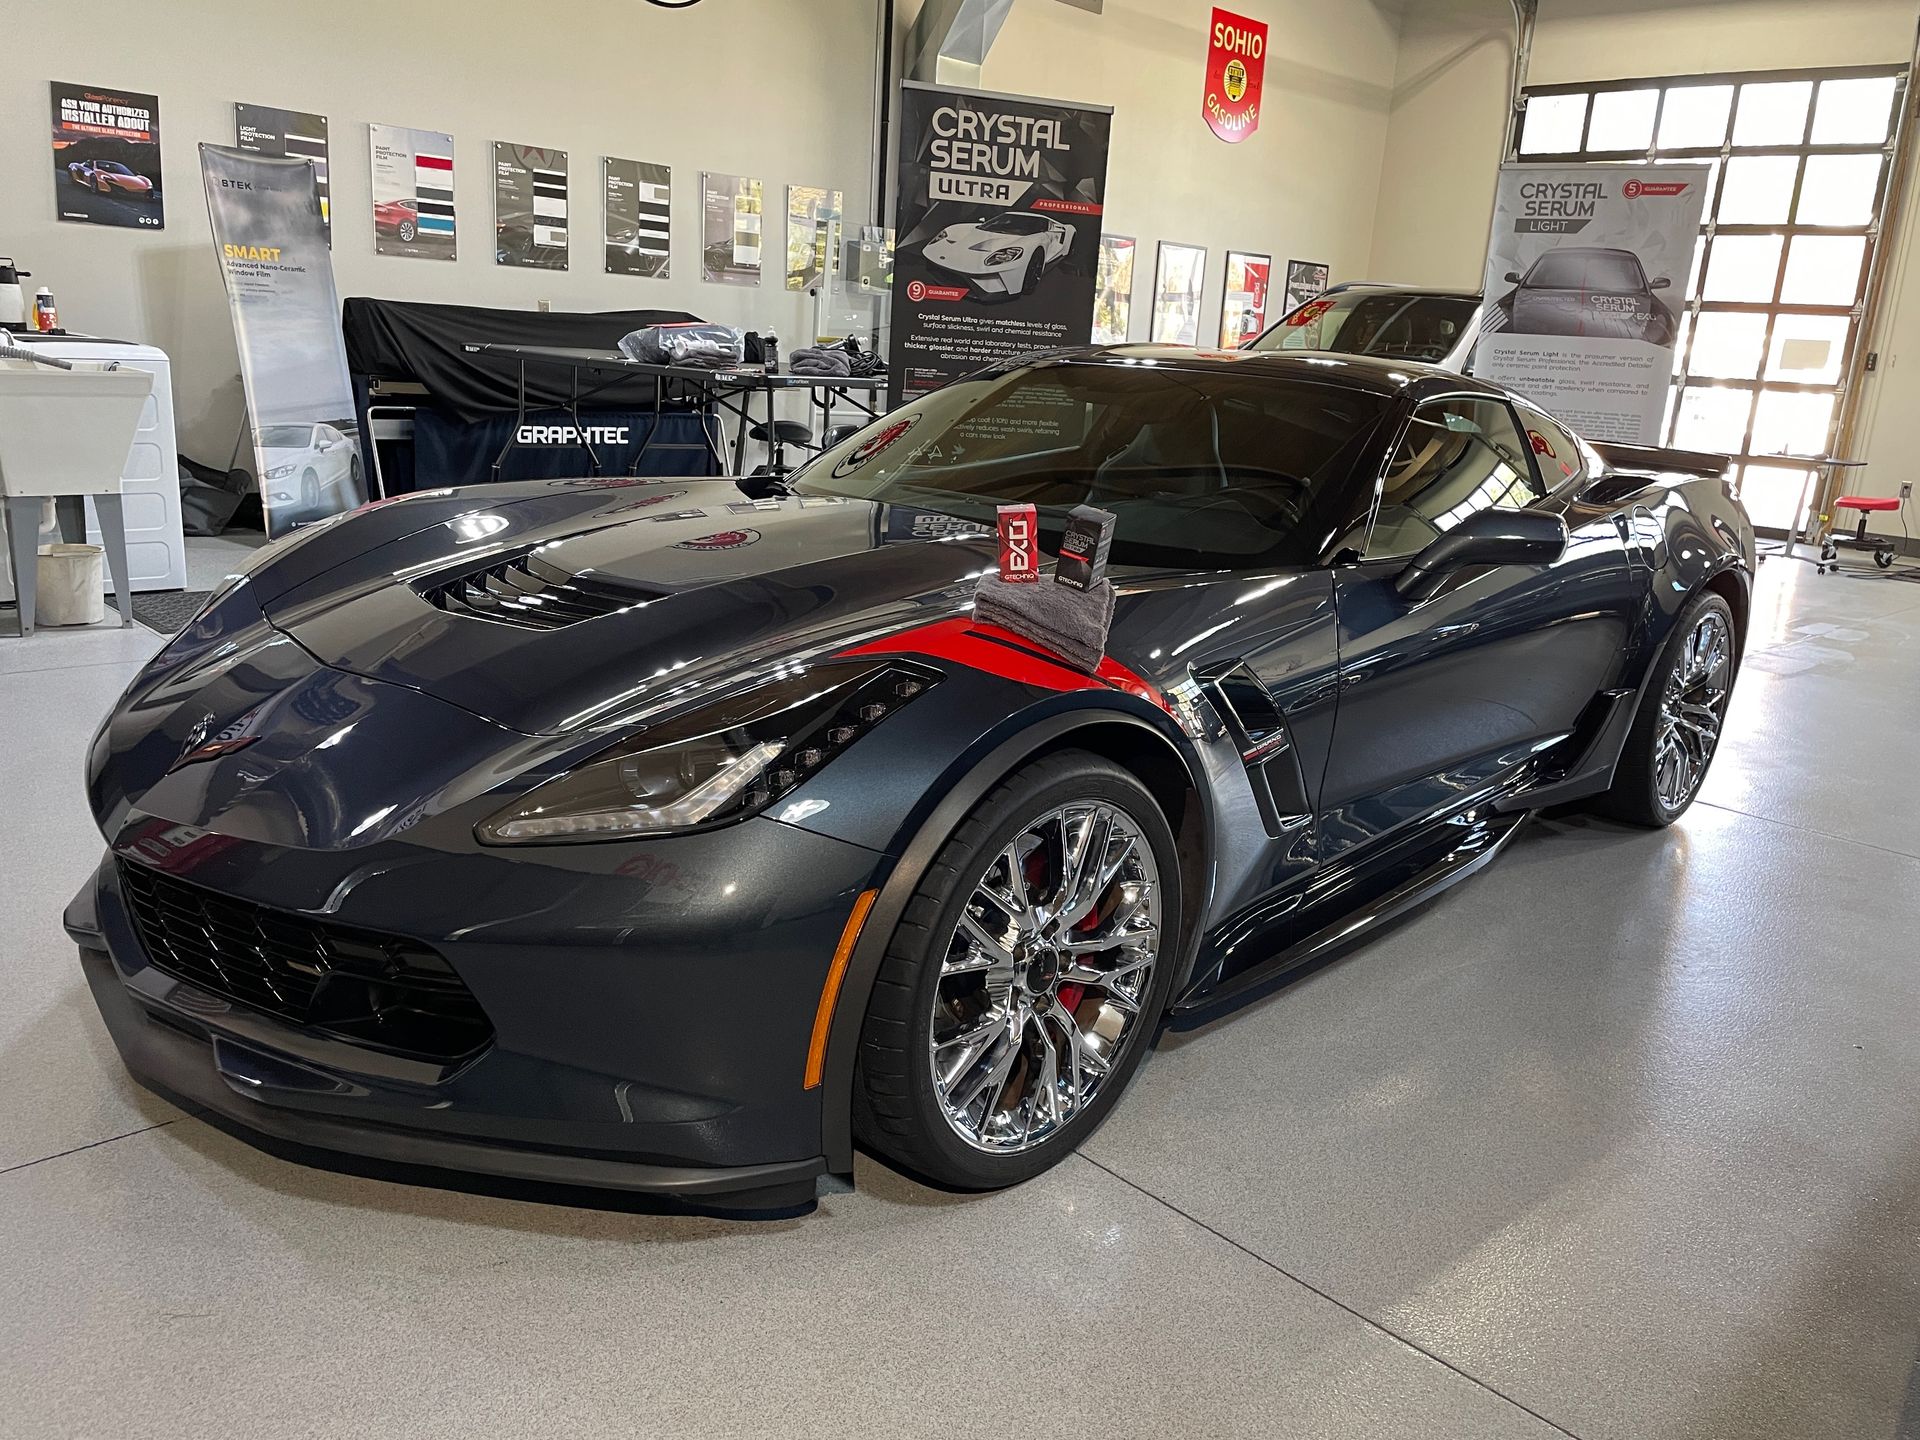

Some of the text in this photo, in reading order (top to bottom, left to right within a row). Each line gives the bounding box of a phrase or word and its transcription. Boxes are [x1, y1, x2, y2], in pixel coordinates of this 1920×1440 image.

[1213, 22, 1263, 59] SOHIO
[79, 100, 100, 112] YOUR
[102, 103, 149, 119] AUTHORIZED
[1207, 93, 1257, 131] GASOLINE
[61, 108, 115, 127] INSTALLER
[240, 125, 257, 133] LIGHT
[932, 106, 1070, 151] CRYSTAL
[240, 131, 276, 140] PROTECTION
[375, 150, 407, 158] PROTECTION
[930, 139, 1040, 178] SERUM
[938, 177, 1010, 200] ULTRA
[1520, 182, 1608, 199] CRYSTAL
[1628, 182, 1637, 193] 5
[1040, 202, 1090, 211] PROFESSIONAL
[1525, 200, 1596, 217] SERUM
[1530, 221, 1568, 232] LIGHT
[224, 243, 280, 263] SMART
[226, 260, 306, 273] Advanced Nano-Ceramic
[228, 268, 255, 277] Window
[912, 284, 921, 295] 9
[928, 289, 959, 297] GUARANTEE
[1591, 295, 1640, 306] CRYSTAL
[1595, 303, 1635, 312] SERUM
[918, 313, 940, 321] Crystal
[941, 314, 961, 322] Serum
[979, 318, 994, 326] gives
[995, 319, 1026, 327] matchless
[923, 321, 946, 329] surface
[911, 334, 940, 342] Extensive
[985, 339, 1016, 349] laboratory
[969, 346, 991, 354] harder
[1494, 348, 1517, 356] Crystal
[1038, 419, 1059, 427] flexible
[516, 425, 630, 444] GRAPHTEC
[1035, 428, 1060, 436] retaining
[1064, 535, 1089, 549] SERUM
[1065, 529, 1096, 546] CRYSTAL
[1008, 520, 1029, 571] EXO
[1058, 574, 1084, 589] GTECHNIQ
